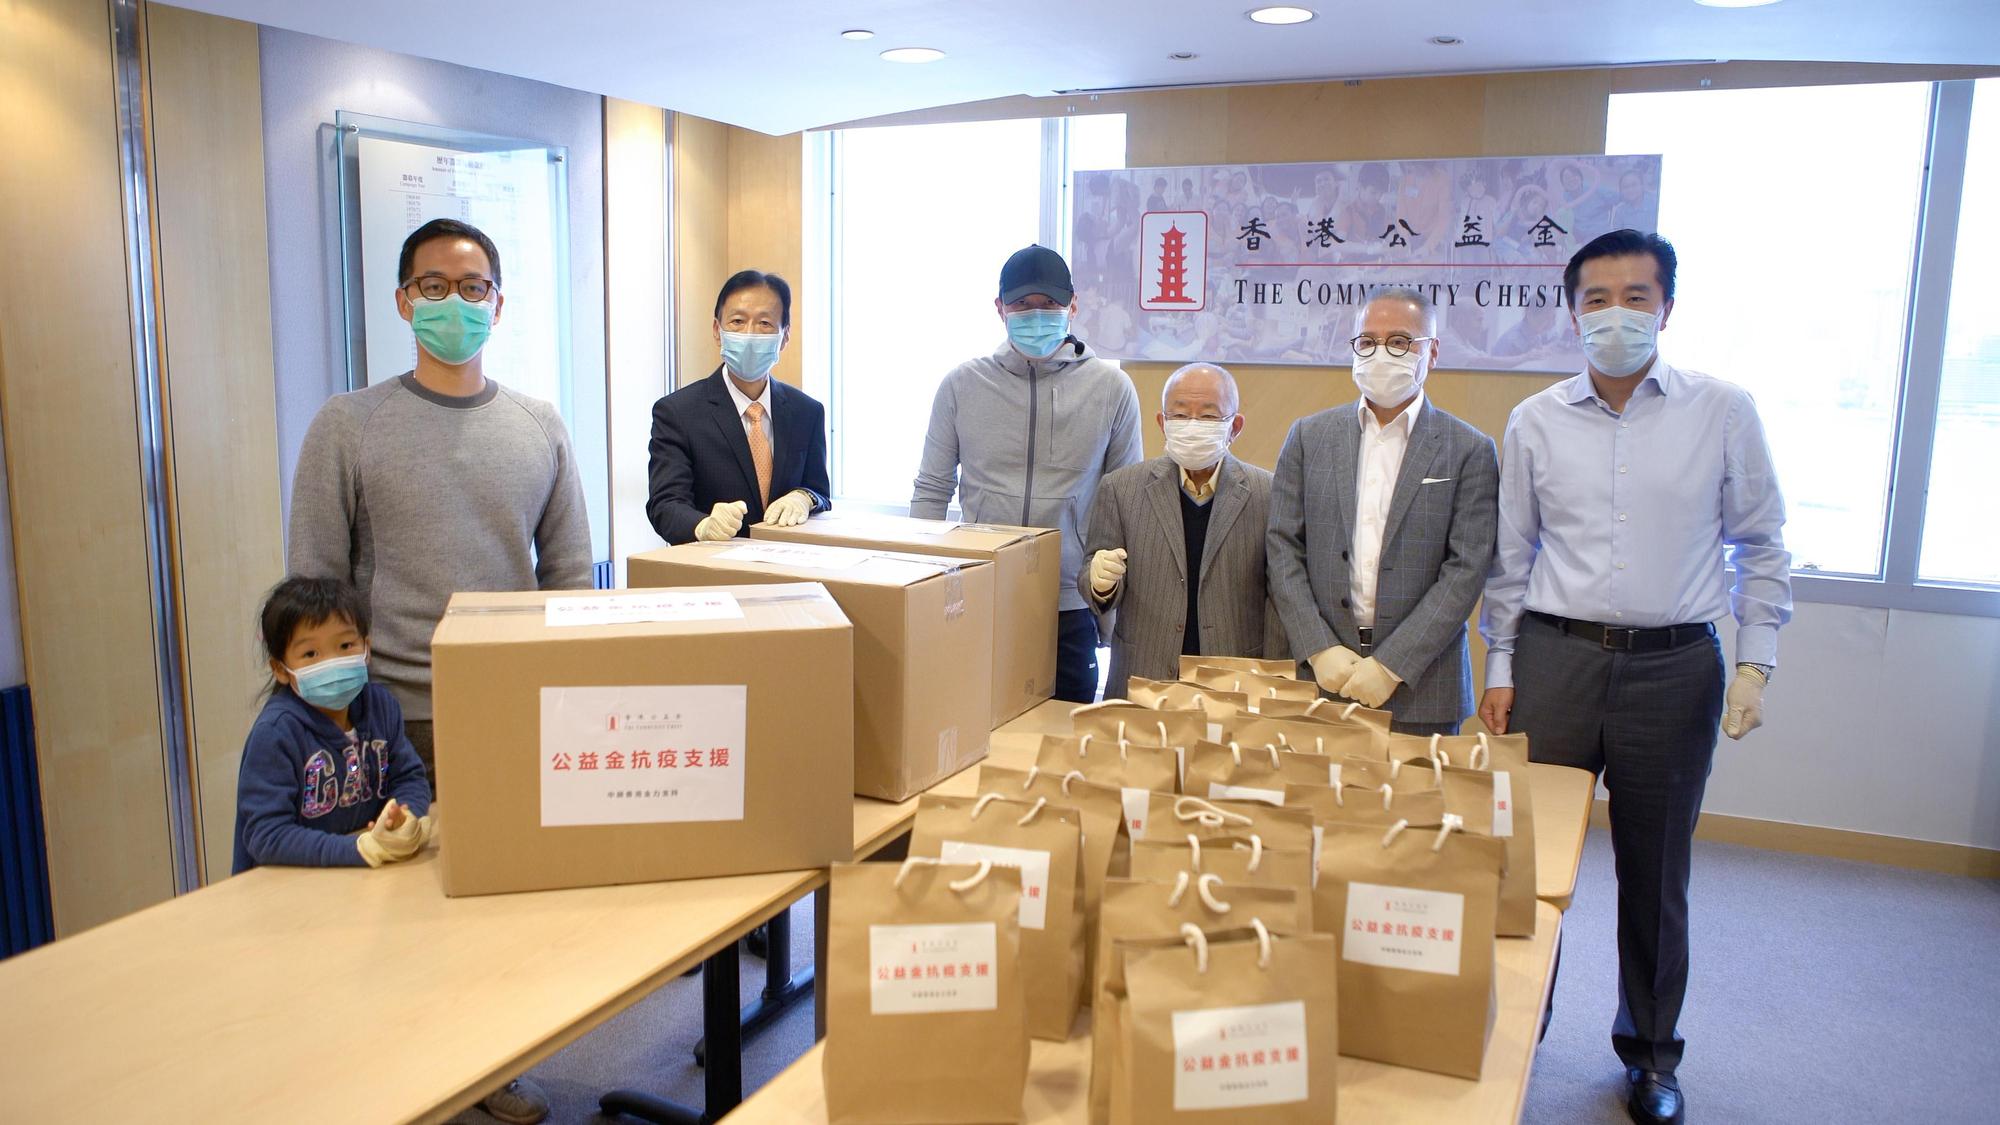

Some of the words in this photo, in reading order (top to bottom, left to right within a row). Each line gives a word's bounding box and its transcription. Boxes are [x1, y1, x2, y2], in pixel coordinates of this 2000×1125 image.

[1236, 215, 1568, 251] 香港公益金
[1234, 279, 1283, 305] THE
[1297, 279, 1460, 306] COMMTY
[1475, 280, 1566, 307] CHEST
[551, 747, 731, 771] 公益金抗疫支援
[1351, 918, 1455, 942] 公益金抗疫支援
